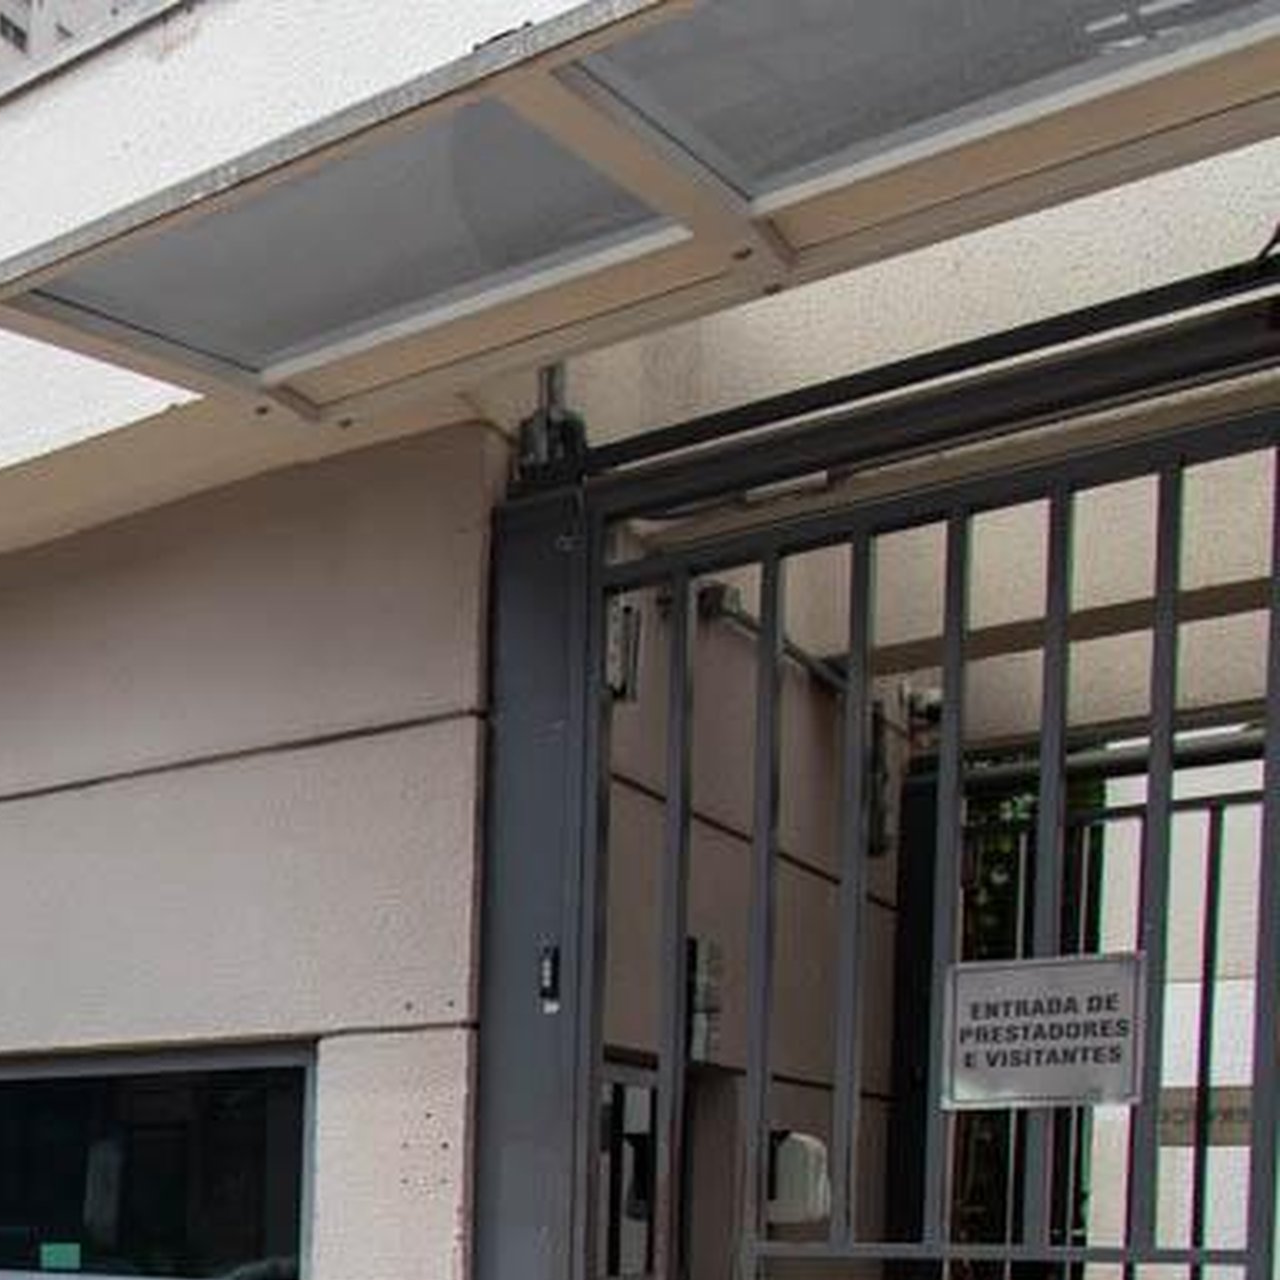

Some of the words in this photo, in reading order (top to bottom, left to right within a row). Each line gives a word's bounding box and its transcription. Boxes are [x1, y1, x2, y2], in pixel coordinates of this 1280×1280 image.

[970, 995, 1079, 1021] ENTRADA
[1086, 992, 1120, 1013] DE
[959, 1018, 1130, 1045] PRESTADORES
[964, 1051, 976, 1068] E
[985, 1045, 1122, 1068] VISITANTES
